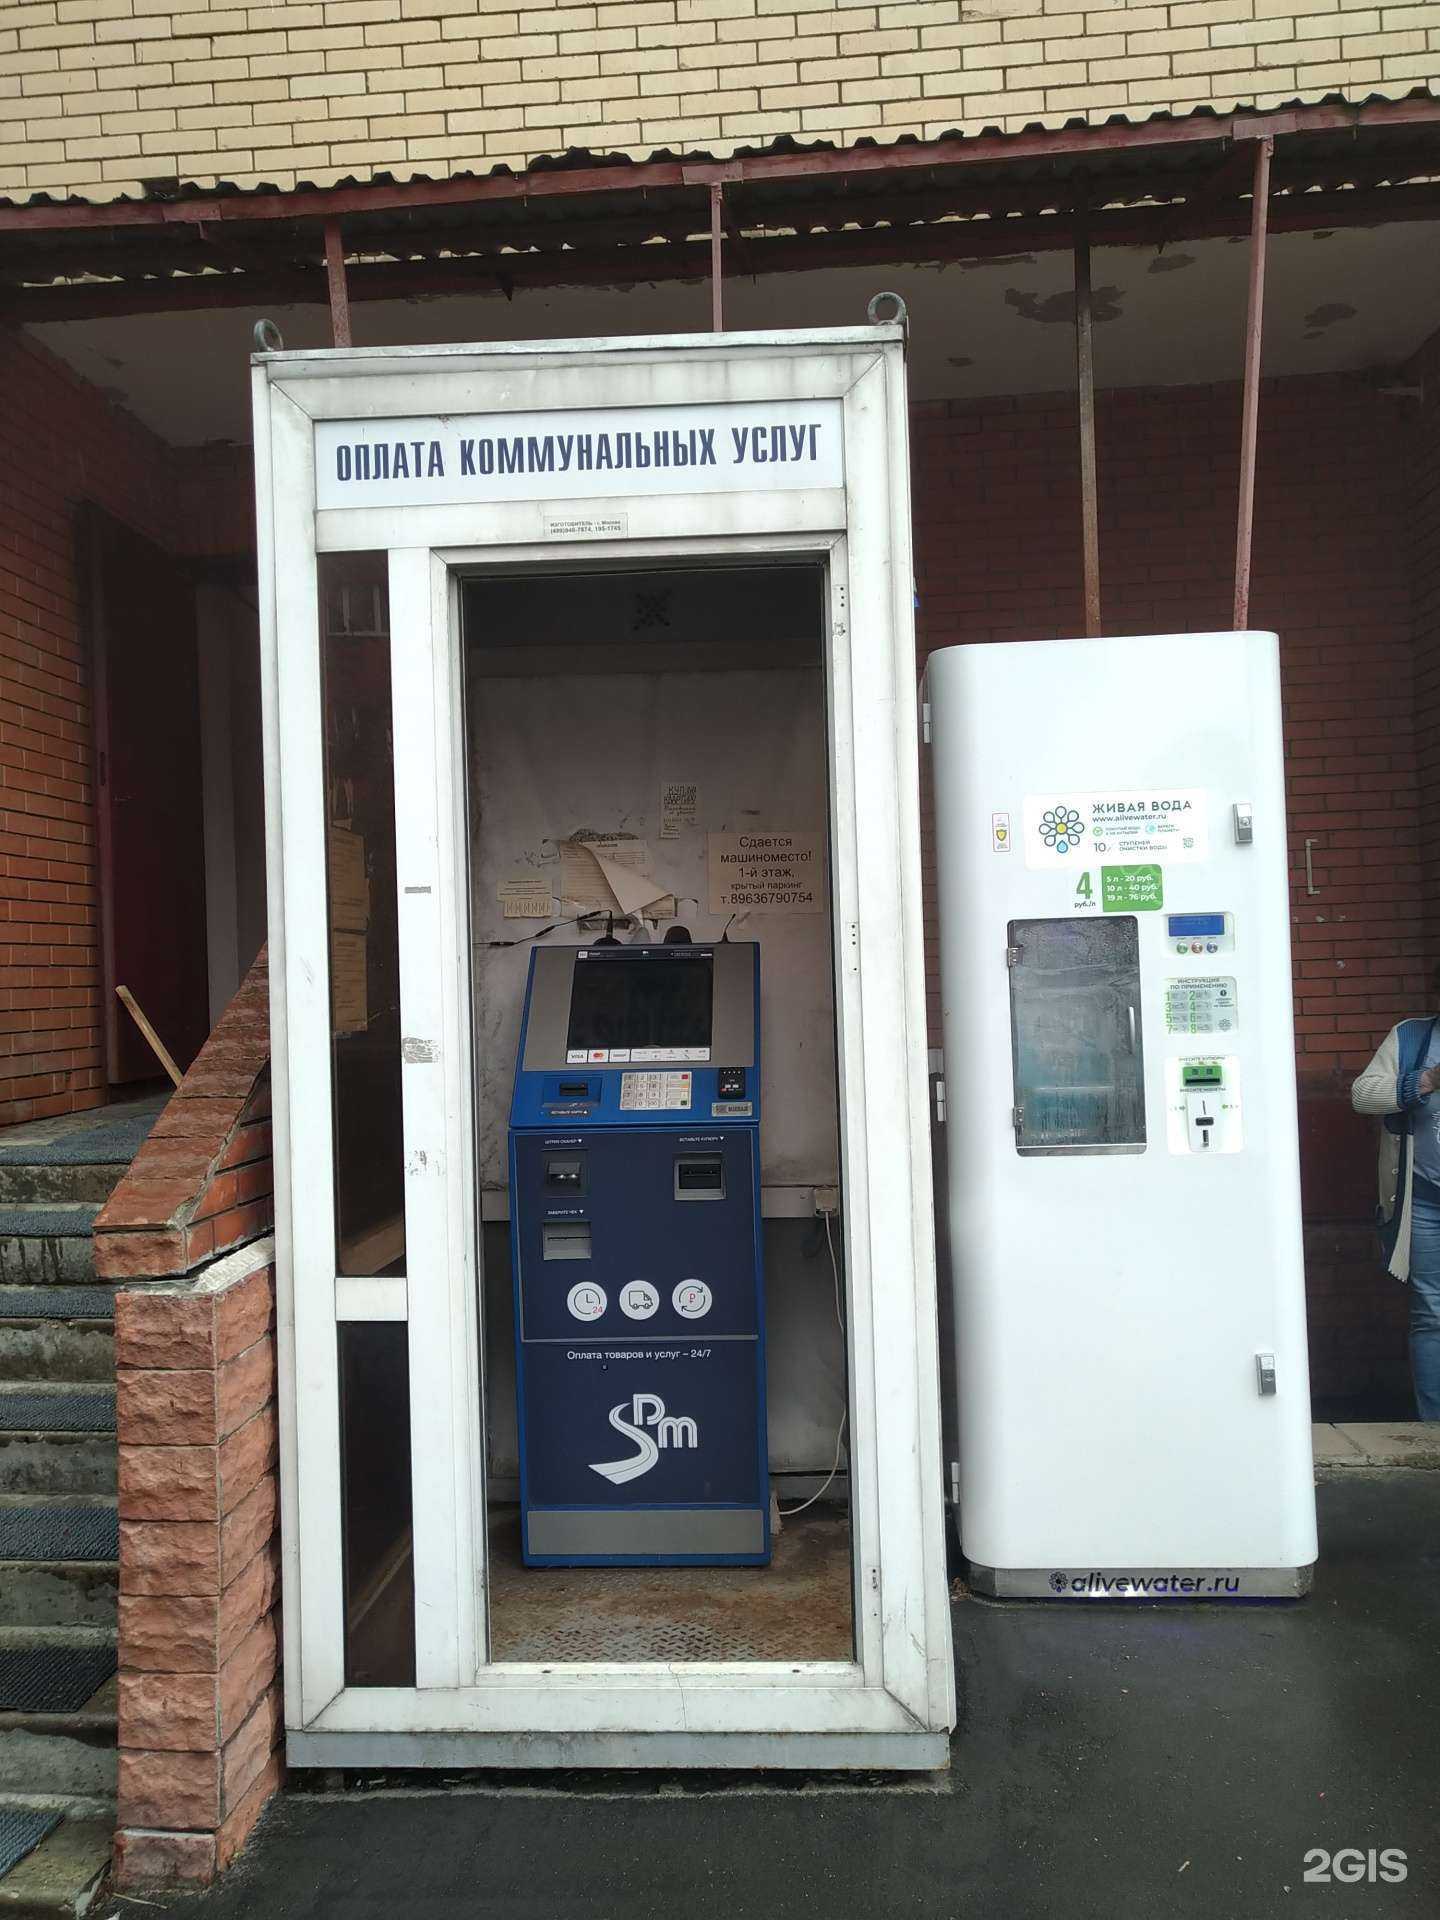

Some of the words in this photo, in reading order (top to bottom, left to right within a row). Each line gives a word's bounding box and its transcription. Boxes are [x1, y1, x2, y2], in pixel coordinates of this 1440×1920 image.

[336, 440, 445, 482] ОПЛАТА
[460, 429, 717, 476] КОММУНАЛЬНЫХ
[733, 423, 822, 464] УСЛУГ
[1092, 801, 1145, 814] ЖИВАЯ
[1151, 800, 1192, 812] ВОДА
[1092, 814, 1167, 823] www.alivewater.ru
[739, 836, 793, 849] Сдается
[1093, 842, 1106, 852] 10
[720, 851, 812, 863] машиноместо!
[739, 867, 758, 878] 1-й
[731, 882, 765, 891] крытый
[767, 881, 802, 891] паркинг
[1076, 872, 1093, 900] 4
[720, 892, 813, 905] т.89636790754
[592, 1306, 603, 1314] 24
[567, 1350, 602, 1361] Оплата
[604, 1350, 644, 1360] товаров
[654, 1350, 681, 1361] услуг
[690, 1349, 712, 1359] 24/7
[1071, 1572, 1240, 1593] alivewater.ru
